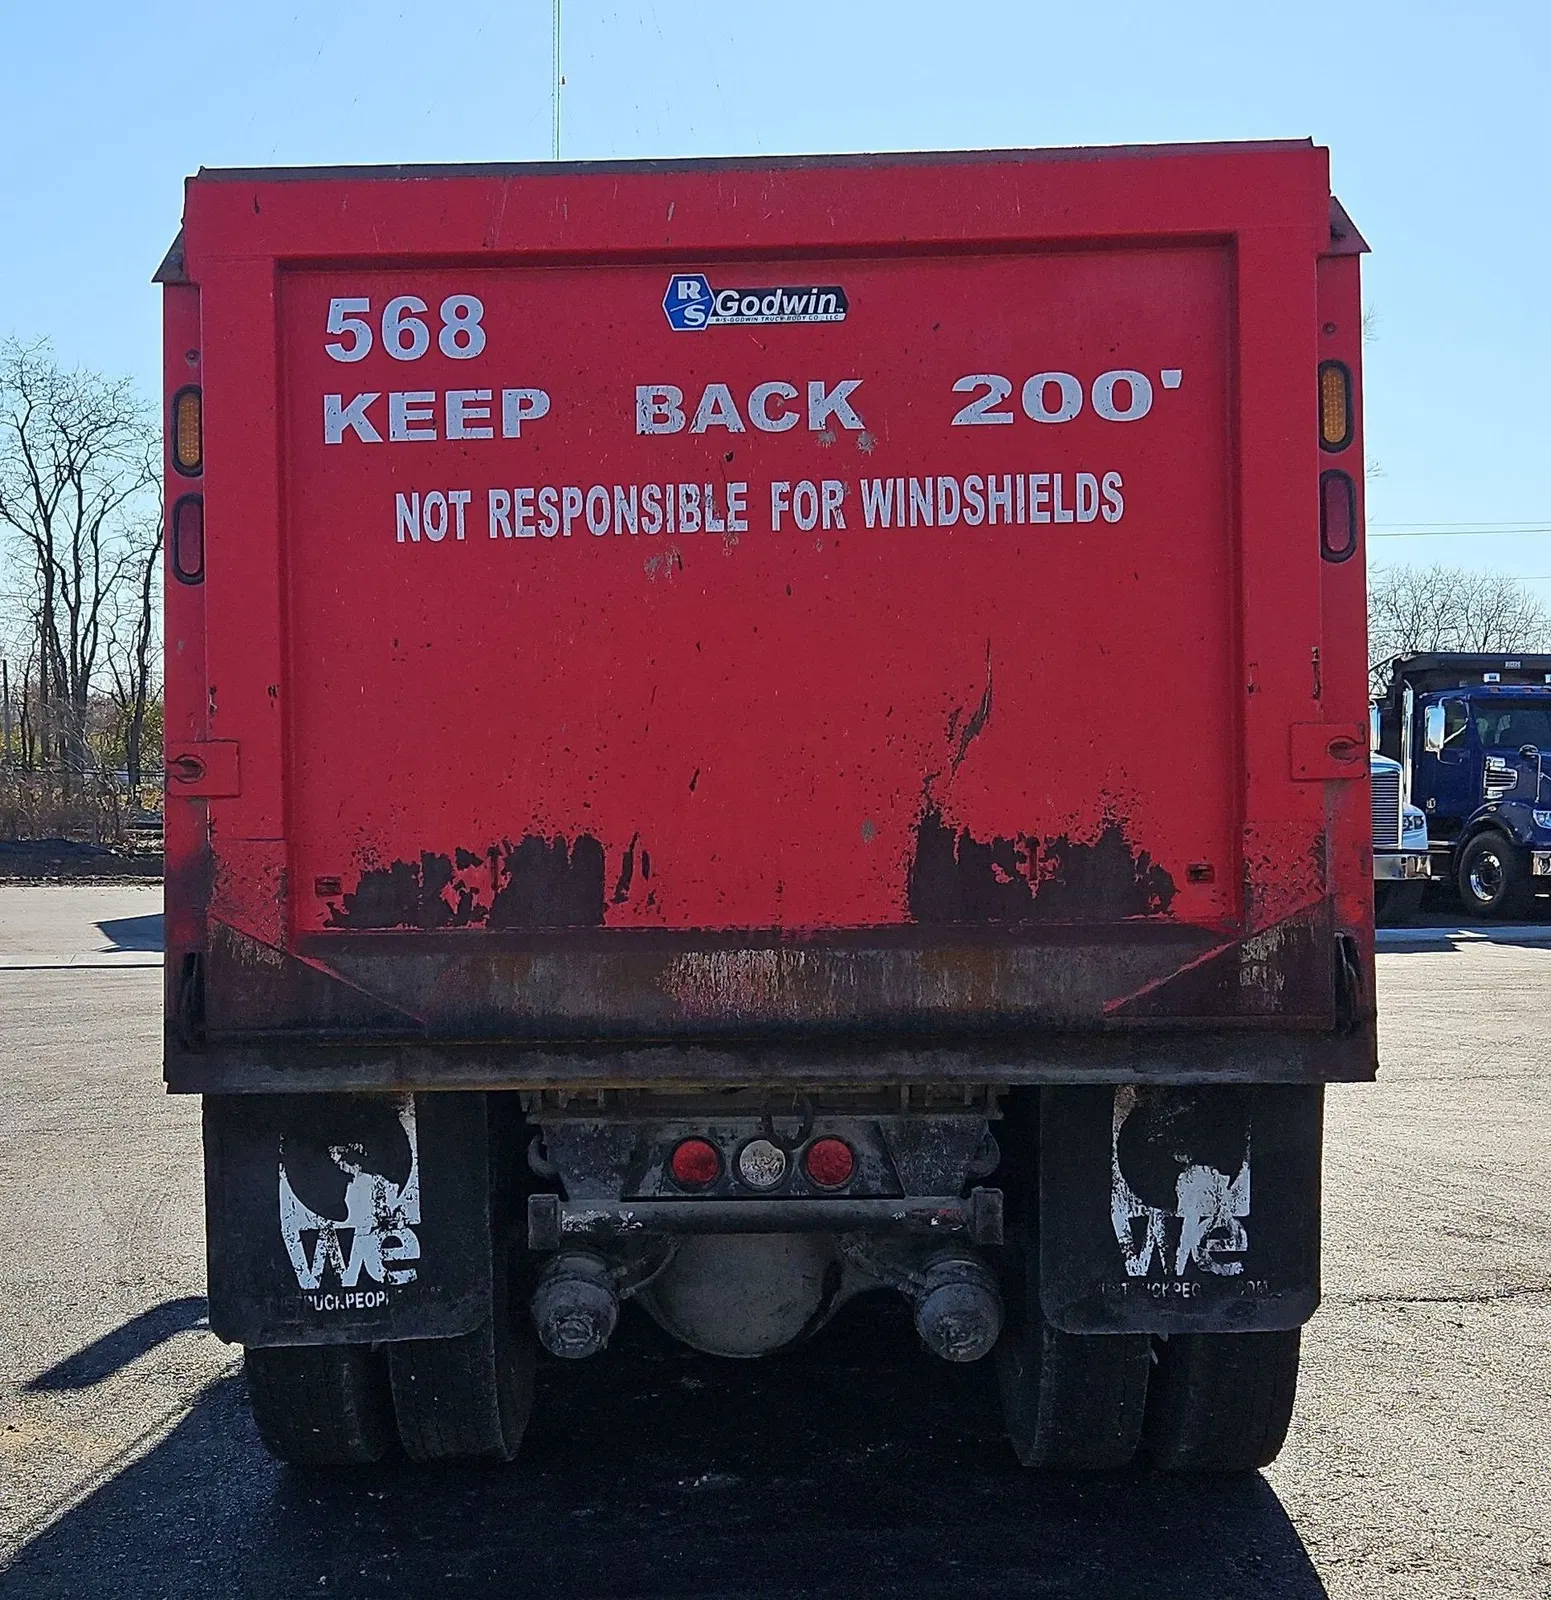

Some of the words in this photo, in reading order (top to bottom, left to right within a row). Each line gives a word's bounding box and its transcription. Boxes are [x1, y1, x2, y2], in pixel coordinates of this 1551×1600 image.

[324, 294, 487, 363] 568
[715, 289, 838, 316] Godwin
[323, 388, 551, 444] KEEP
[635, 379, 864, 436] BACK
[951, 368, 1183, 427] 200'
[395, 489, 472, 543] NOT
[488, 481, 749, 539] RESPONSIBLE
[770, 479, 847, 532] FOR
[860, 471, 1125, 529] WINDSHIELDS
